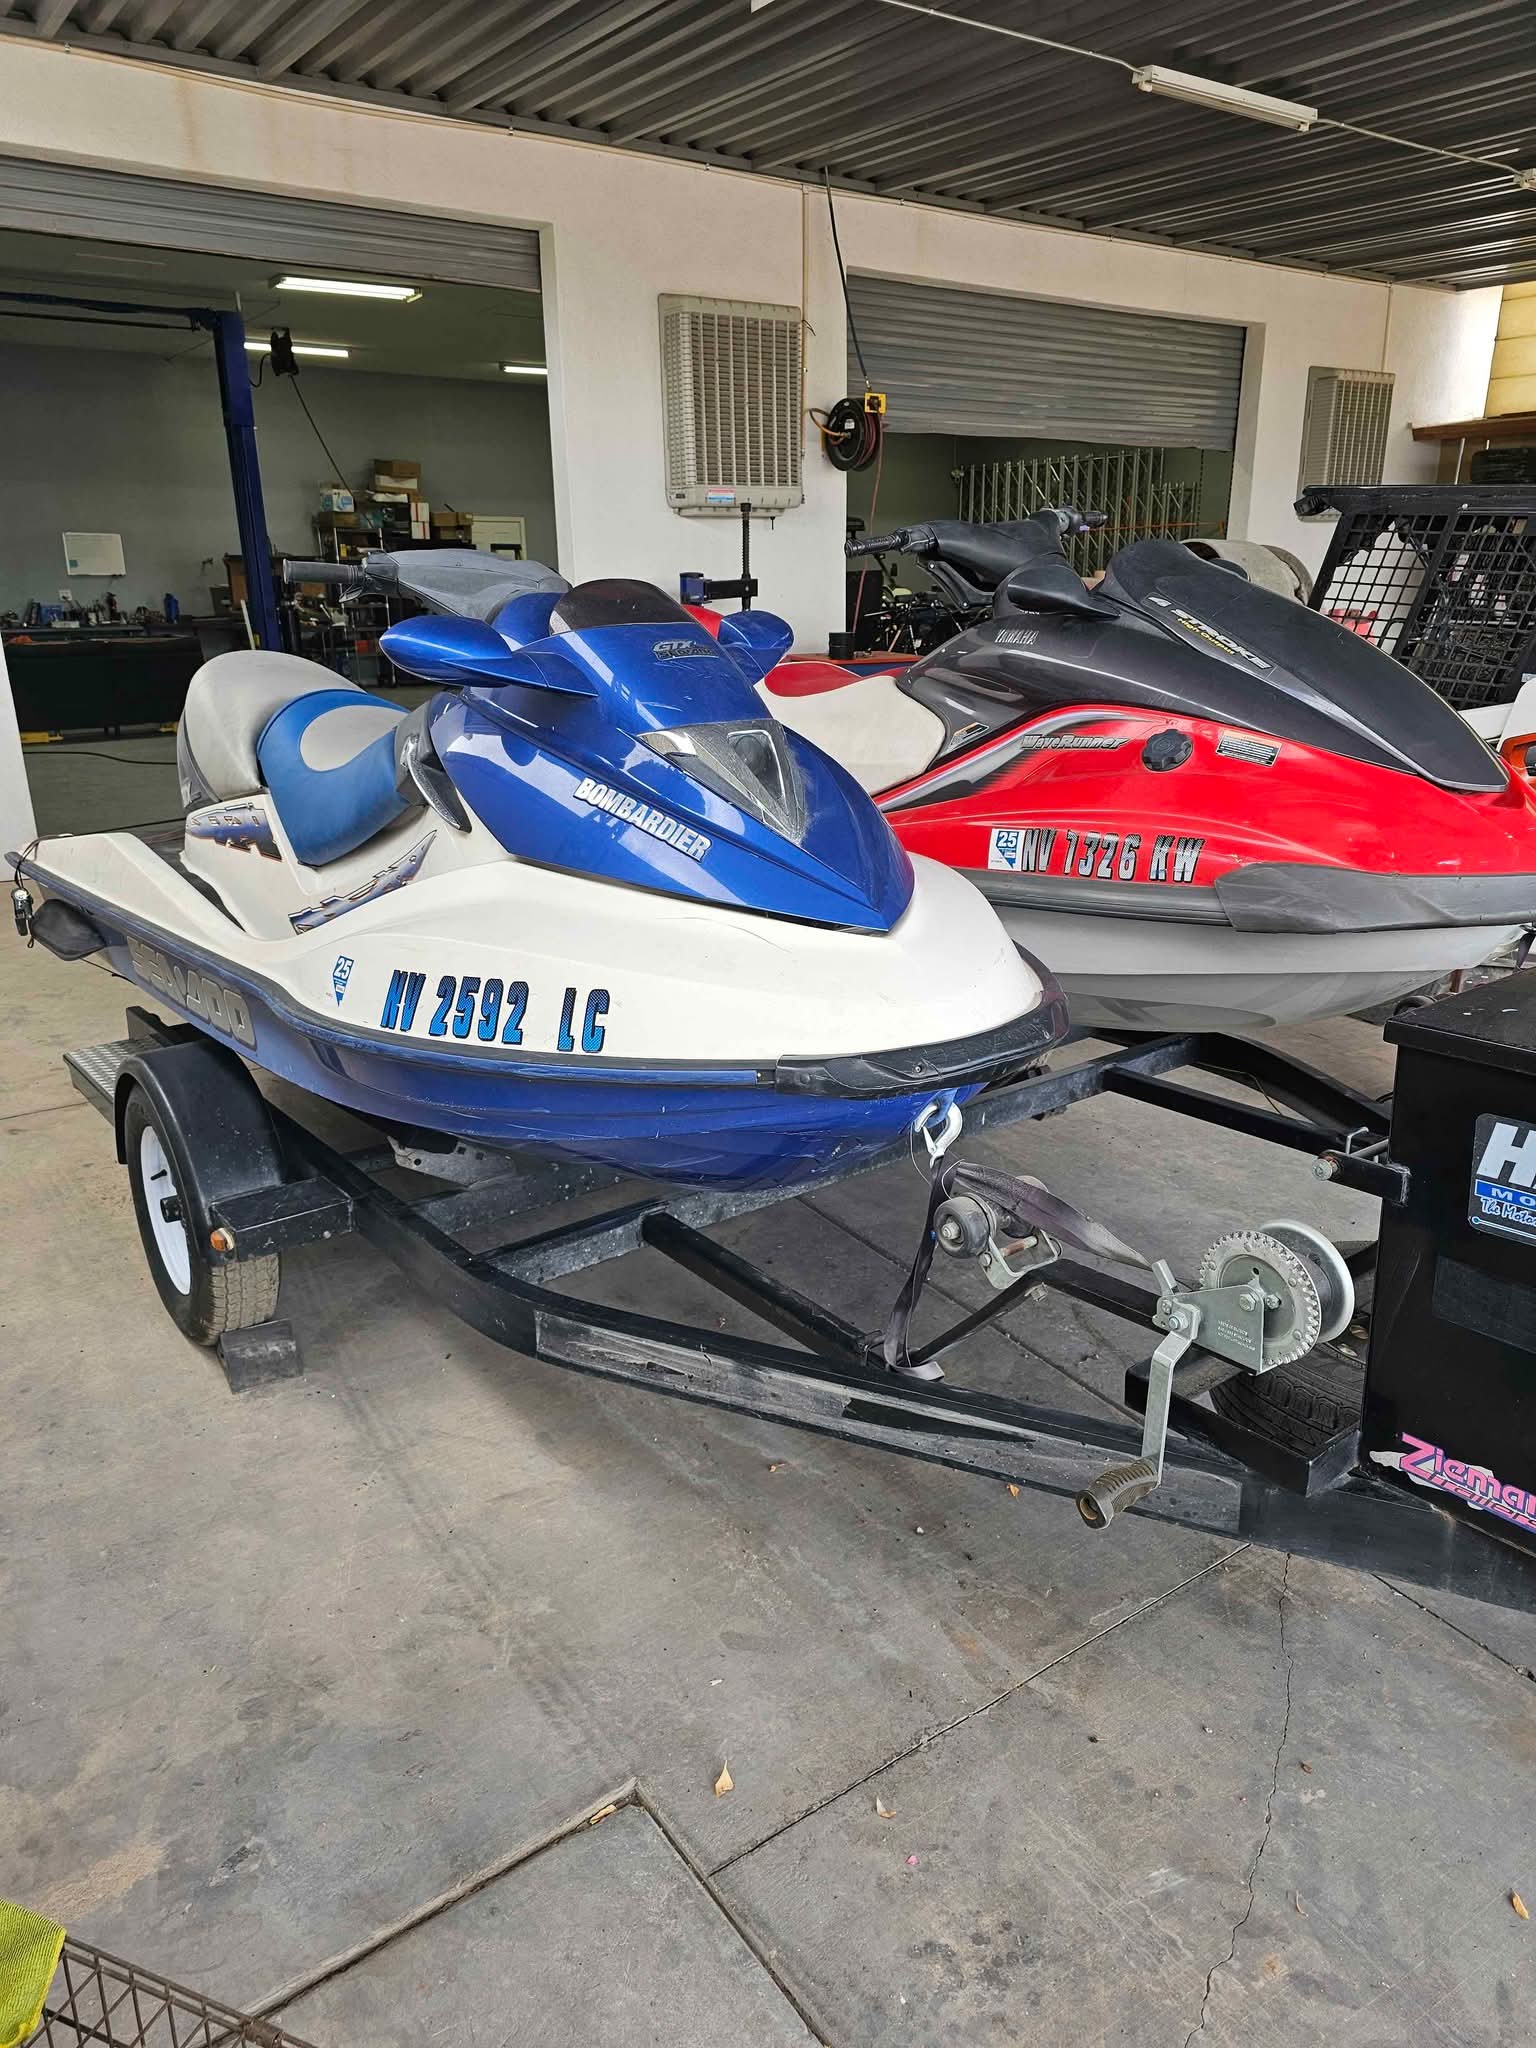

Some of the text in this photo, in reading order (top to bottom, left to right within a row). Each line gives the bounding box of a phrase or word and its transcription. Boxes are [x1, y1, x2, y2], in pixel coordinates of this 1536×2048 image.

[994, 628, 1039, 645] YAMAHA
[1148, 596, 1273, 670] 4 STROKE
[1020, 734, 1130, 750] WaveRunner
[573, 777, 713, 863] BOMBARDIER
[997, 831, 1018, 848] 25
[1022, 828, 1205, 883] NV 1326 KW
[333, 956, 353, 980] 25
[379, 969, 611, 1054] NV 2592 LC
[1480, 1197, 1501, 1216] The
